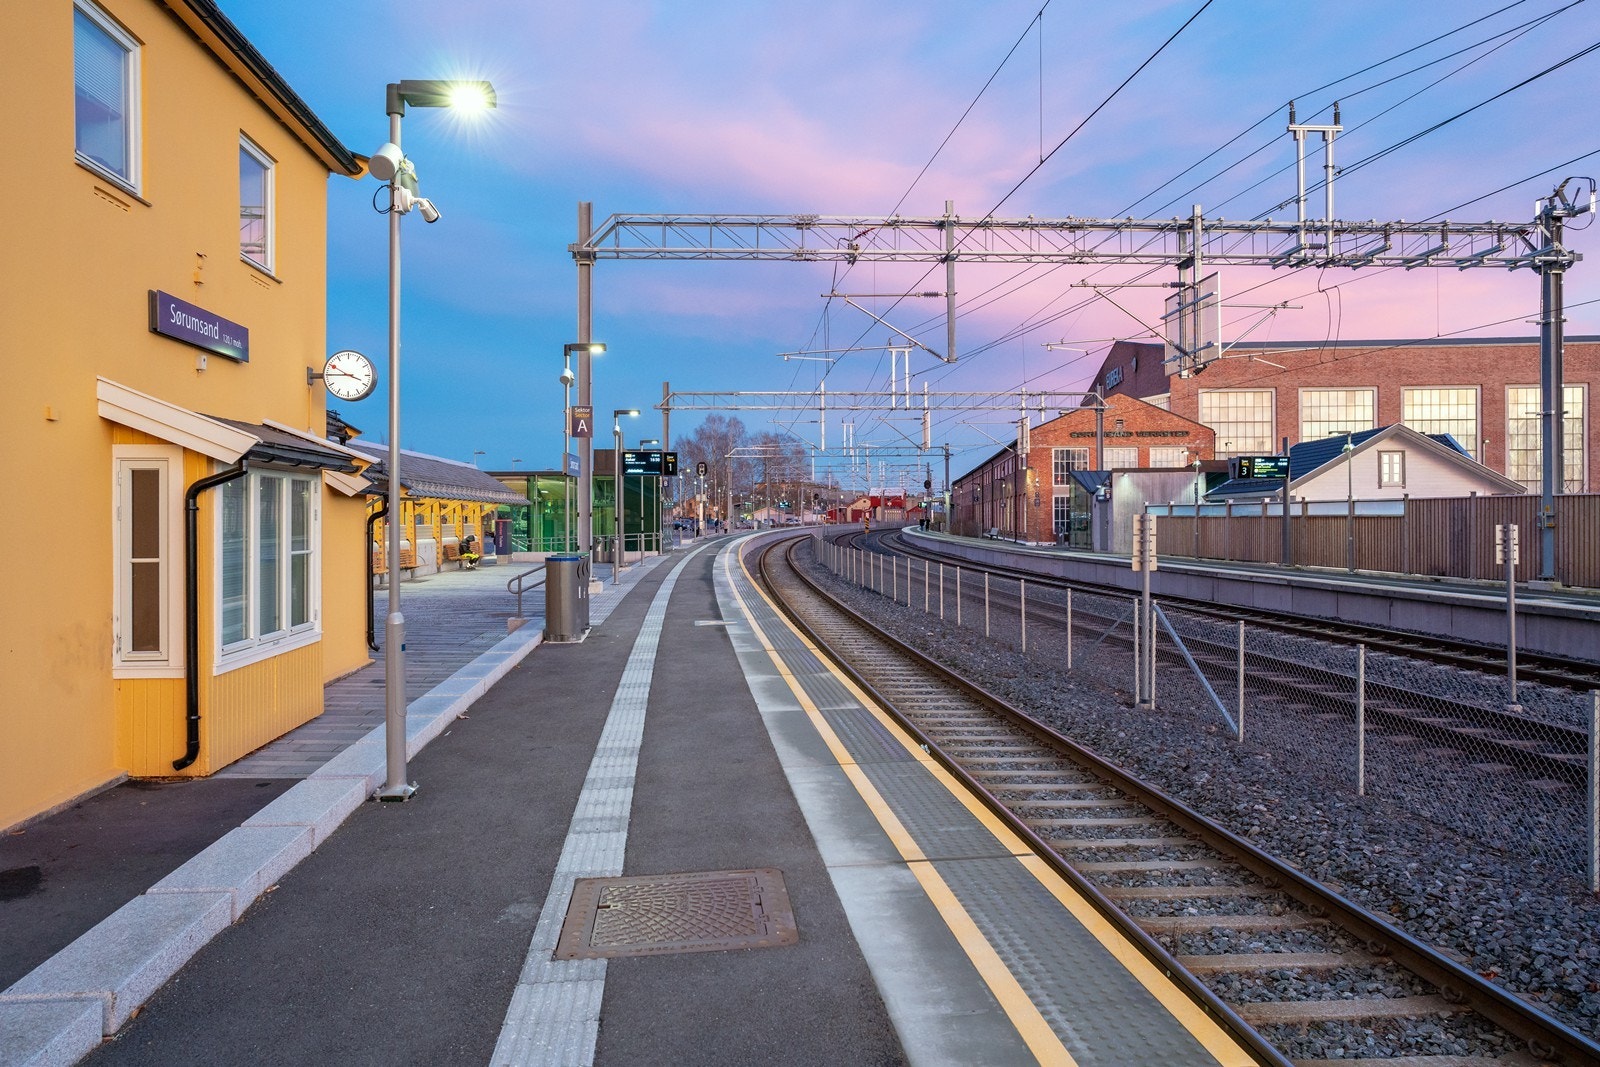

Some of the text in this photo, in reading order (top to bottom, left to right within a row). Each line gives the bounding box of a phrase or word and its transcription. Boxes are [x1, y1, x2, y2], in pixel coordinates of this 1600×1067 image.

[170, 303, 219, 339] Sørumsand
[578, 420, 588, 432] A
[668, 463, 672, 472] 1
[1241, 466, 1247, 475] 3
